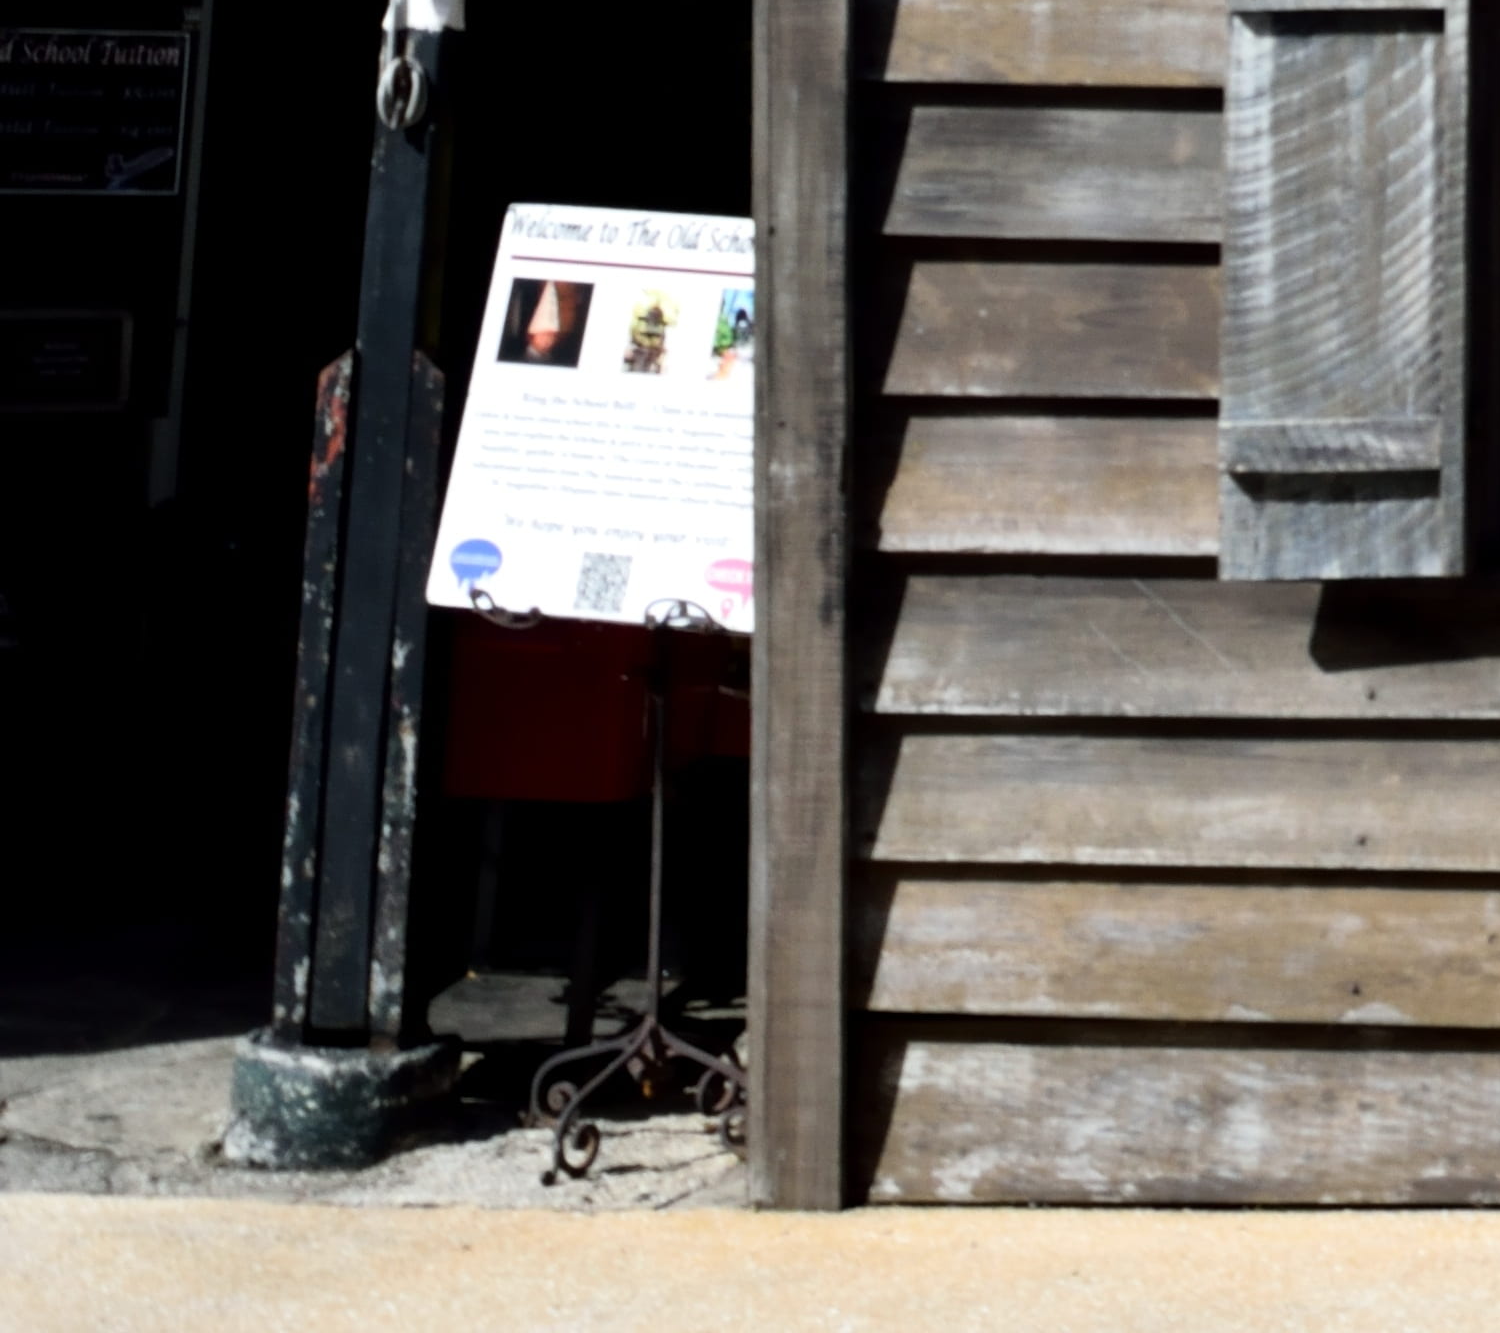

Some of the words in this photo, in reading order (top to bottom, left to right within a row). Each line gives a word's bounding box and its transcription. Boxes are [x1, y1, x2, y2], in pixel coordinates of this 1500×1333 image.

[100, 39, 182, 68] Tuition
[511, 209, 595, 243] Welcome
[599, 221, 621, 246] to
[627, 217, 662, 248] The
[667, 221, 709, 251] Old
